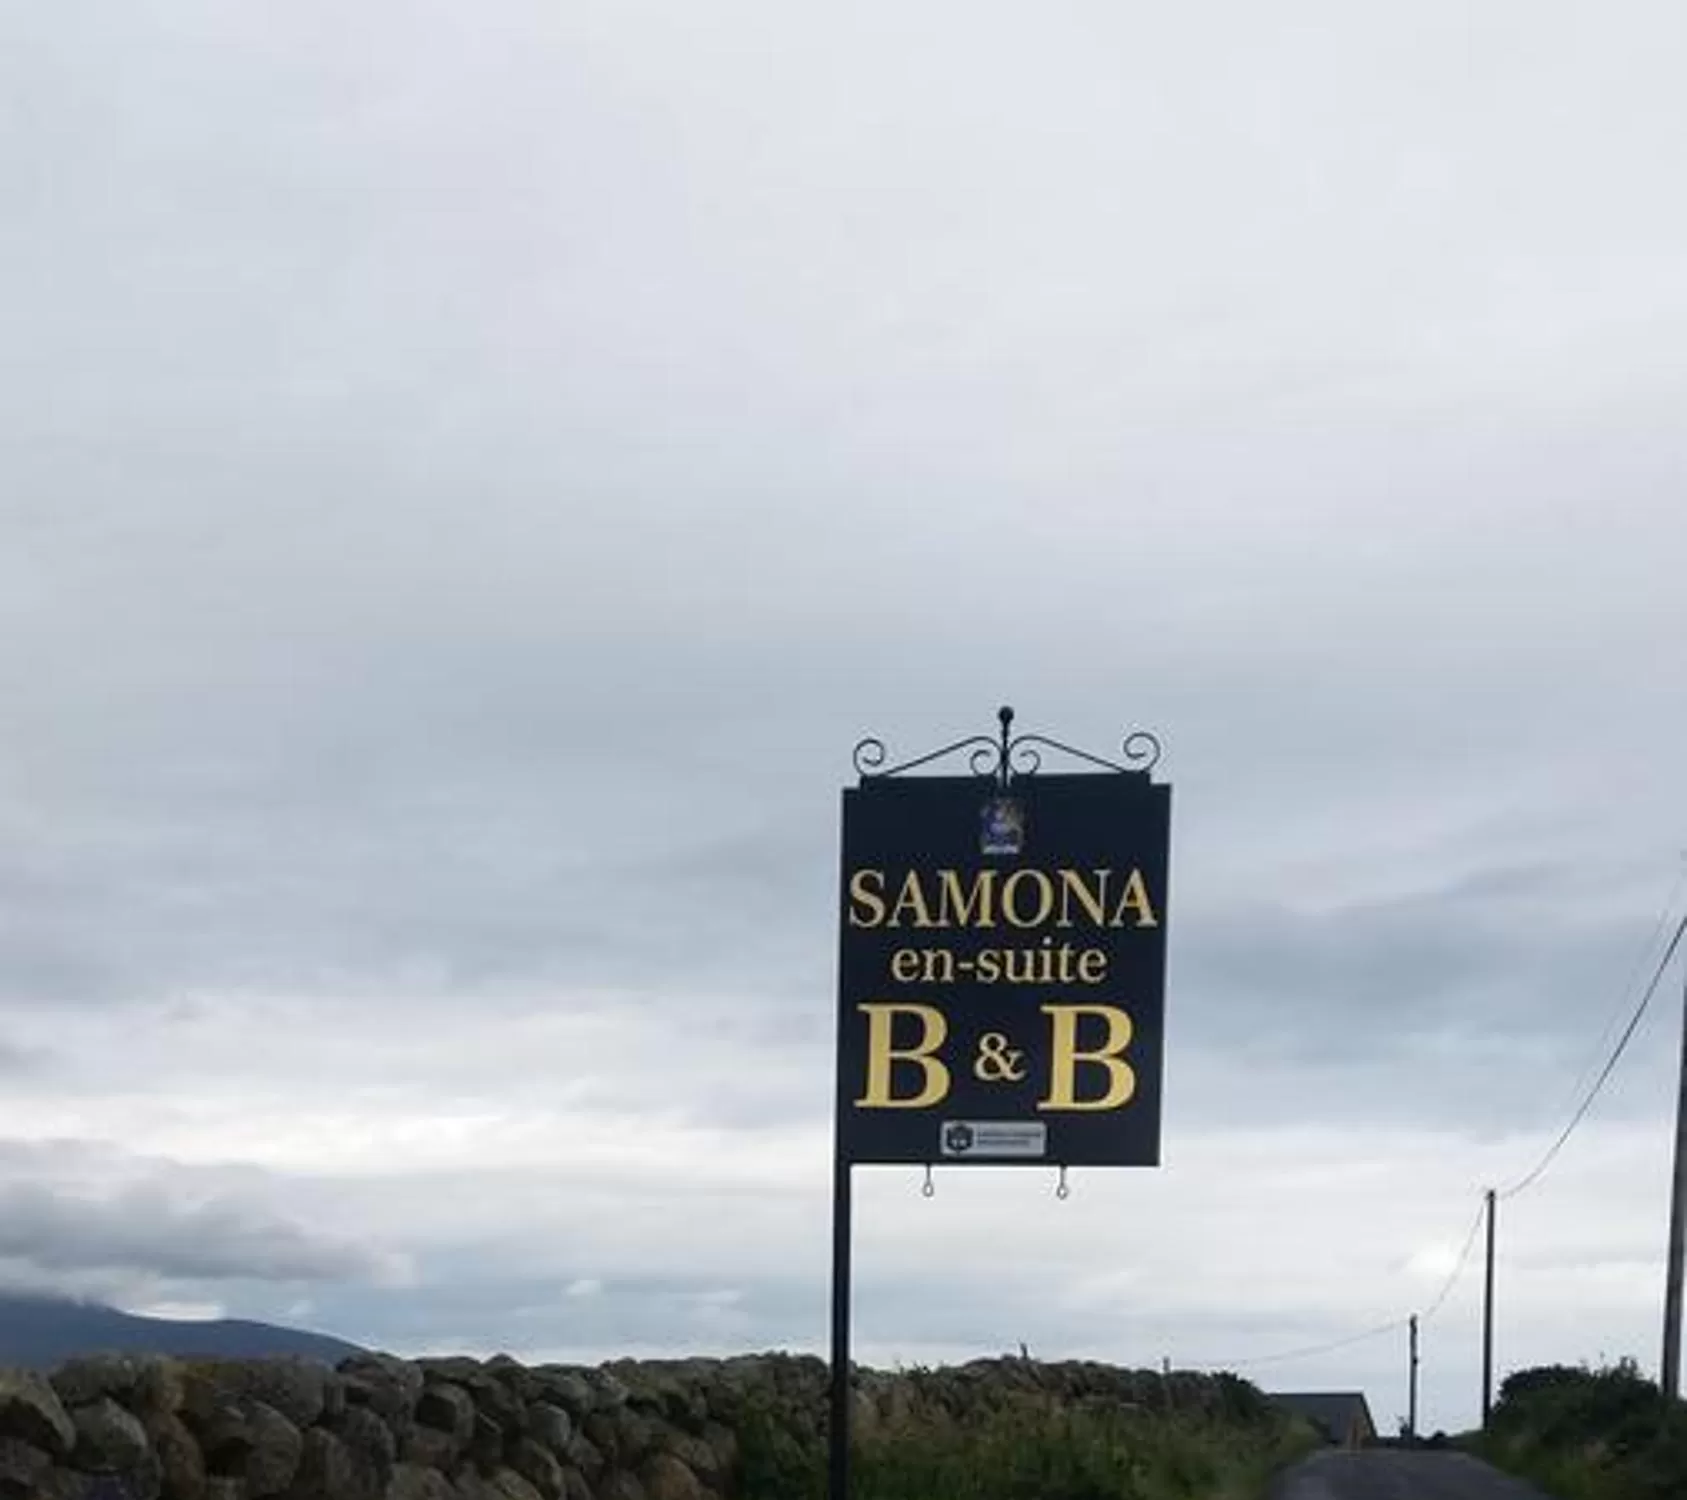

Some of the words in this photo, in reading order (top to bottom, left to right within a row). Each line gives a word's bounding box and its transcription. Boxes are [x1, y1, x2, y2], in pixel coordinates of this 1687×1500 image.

[849, 868, 1158, 928] SAMONA
[891, 936, 1107, 982] en-suite
[853, 1003, 951, 1108] B
[973, 1033, 1026, 1081] &
[1036, 1005, 1135, 1110] B
